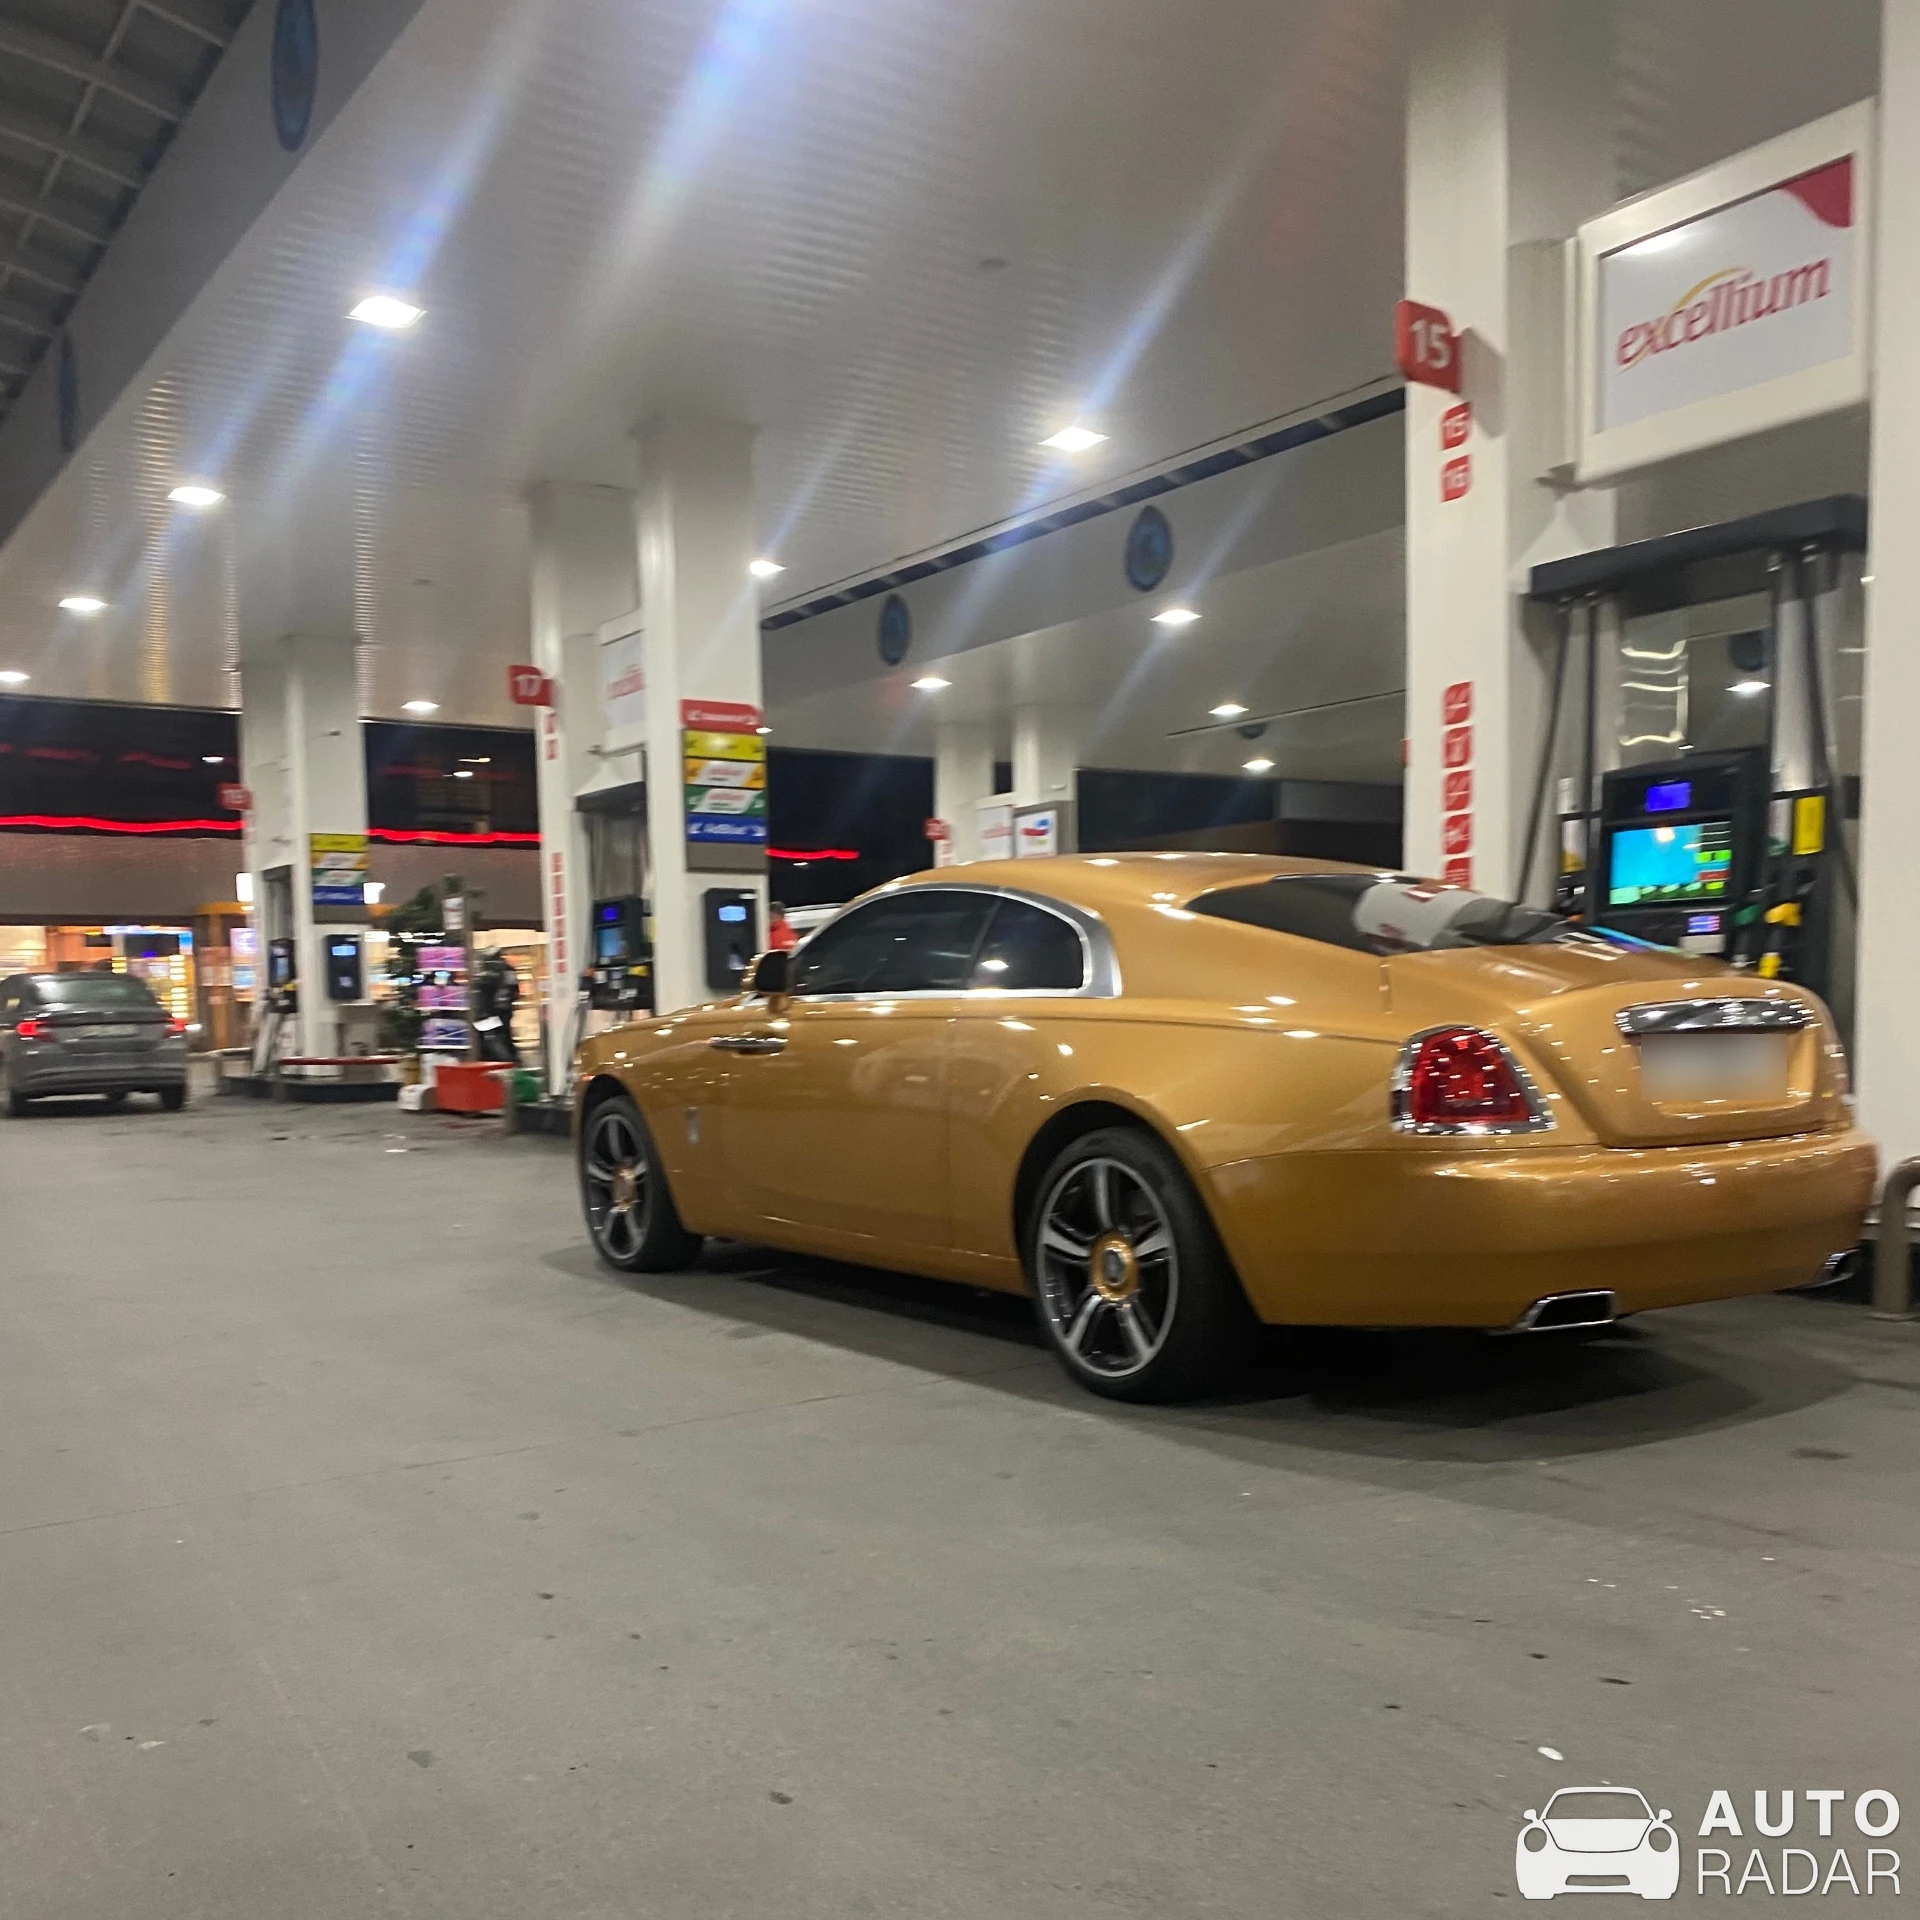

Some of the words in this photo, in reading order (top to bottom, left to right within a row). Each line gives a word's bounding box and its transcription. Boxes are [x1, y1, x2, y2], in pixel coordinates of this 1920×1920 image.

[1616, 258, 1831, 368] excellium
[1411, 319, 1451, 369] 15
[515, 674, 543, 697] 17
